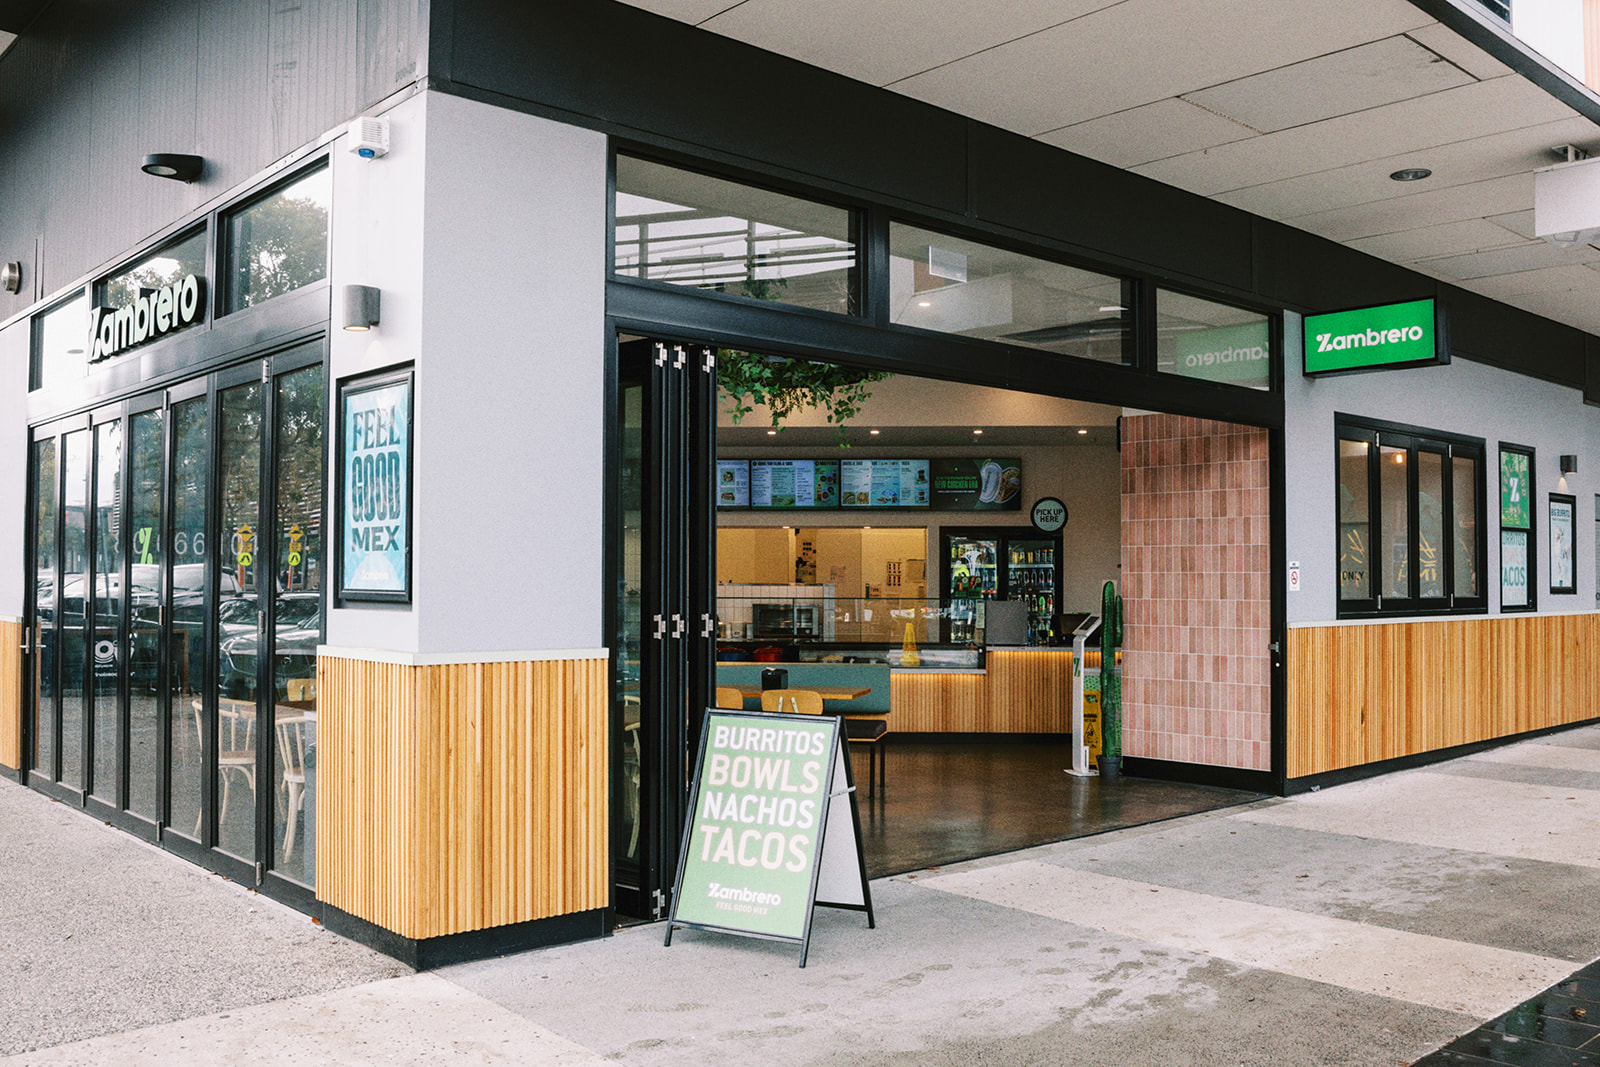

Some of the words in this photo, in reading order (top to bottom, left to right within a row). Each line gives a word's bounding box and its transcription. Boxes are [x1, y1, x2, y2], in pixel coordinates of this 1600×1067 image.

[87, 274, 198, 363] Zambrero
[1316, 325, 1423, 352] Zambrero
[352, 405, 401, 451] FEEL
[351, 450, 401, 522] GOOD
[1036, 508, 1053, 516] PICK
[1053, 508, 1063, 516] UP
[1040, 515, 1060, 523] HERE
[351, 525, 400, 552] MEX
[1503, 547, 1525, 565] OWLS
[1502, 567, 1526, 586] ACOS
[713, 725, 826, 757] BURRITOS
[707, 753, 821, 795] BOWLS
[702, 790, 816, 829] NACHOS
[699, 825, 810, 873] TACOS
[707, 882, 781, 906] Zambrero
[715, 901, 732, 911] FEEL
[733, 903, 752, 913] GOOD
[753, 906, 769, 916] MEX
